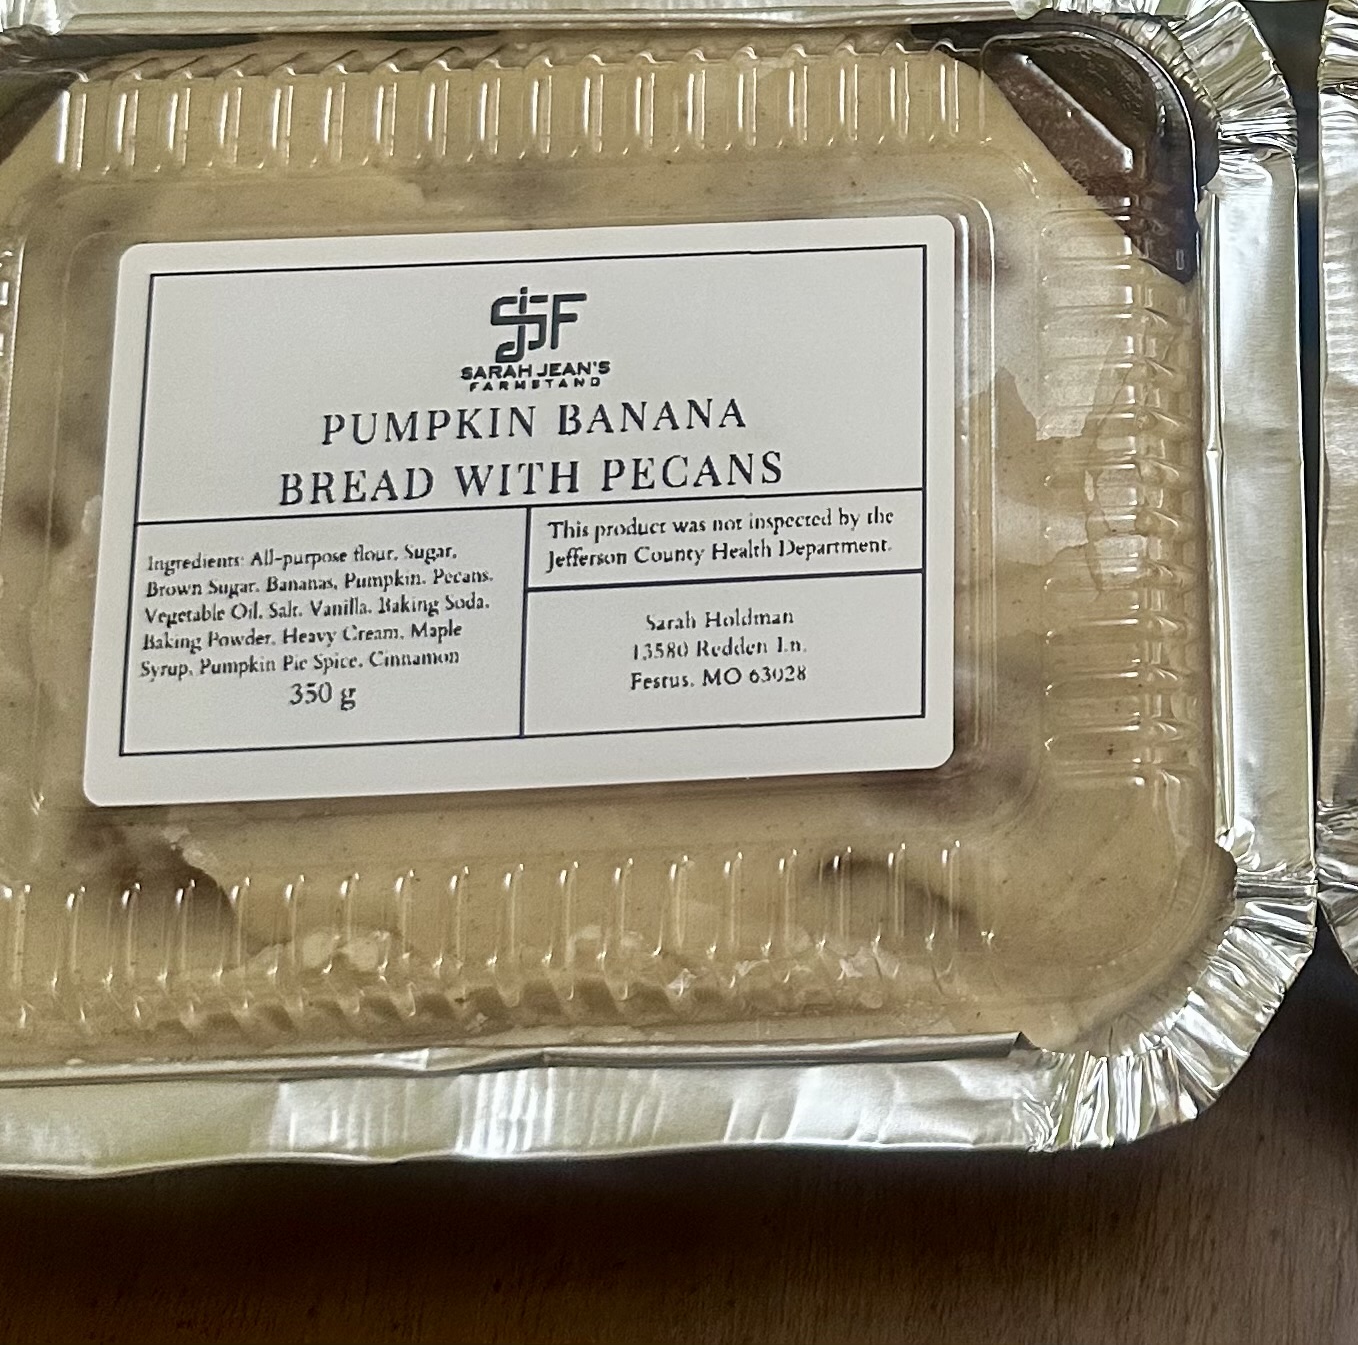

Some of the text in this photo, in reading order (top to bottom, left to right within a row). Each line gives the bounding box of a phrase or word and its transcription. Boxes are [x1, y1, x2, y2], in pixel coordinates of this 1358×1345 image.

[460, 361, 611, 381] SARAH JEAN'S
[469, 377, 602, 392] FARMSTAND
[321, 398, 746, 446] PUMPKIN BANANA
[278, 450, 782, 506] BREAD WITH PECANS
[547, 506, 894, 542] This product was not inspected by the
[250, 548, 348, 571] All-purpose
[545, 547, 627, 574] Jefferson
[634, 546, 705, 566] County
[712, 538, 772, 561] Health
[147, 581, 203, 598] Brown
[145, 603, 226, 629] Vegetable
[378, 594, 440, 617] Baking
[646, 607, 794, 631] Sarah Holdman
[143, 632, 202, 655] Baking
[282, 627, 337, 648] Heavy
[411, 619, 462, 644] Maple
[697, 636, 768, 658] Redden
[199, 655, 276, 679] Pumpkin
[283, 655, 308, 672] Pie
[368, 650, 459, 668] Cinnamon
[702, 667, 742, 687] MO
[288, 682, 356, 712] 350 g
